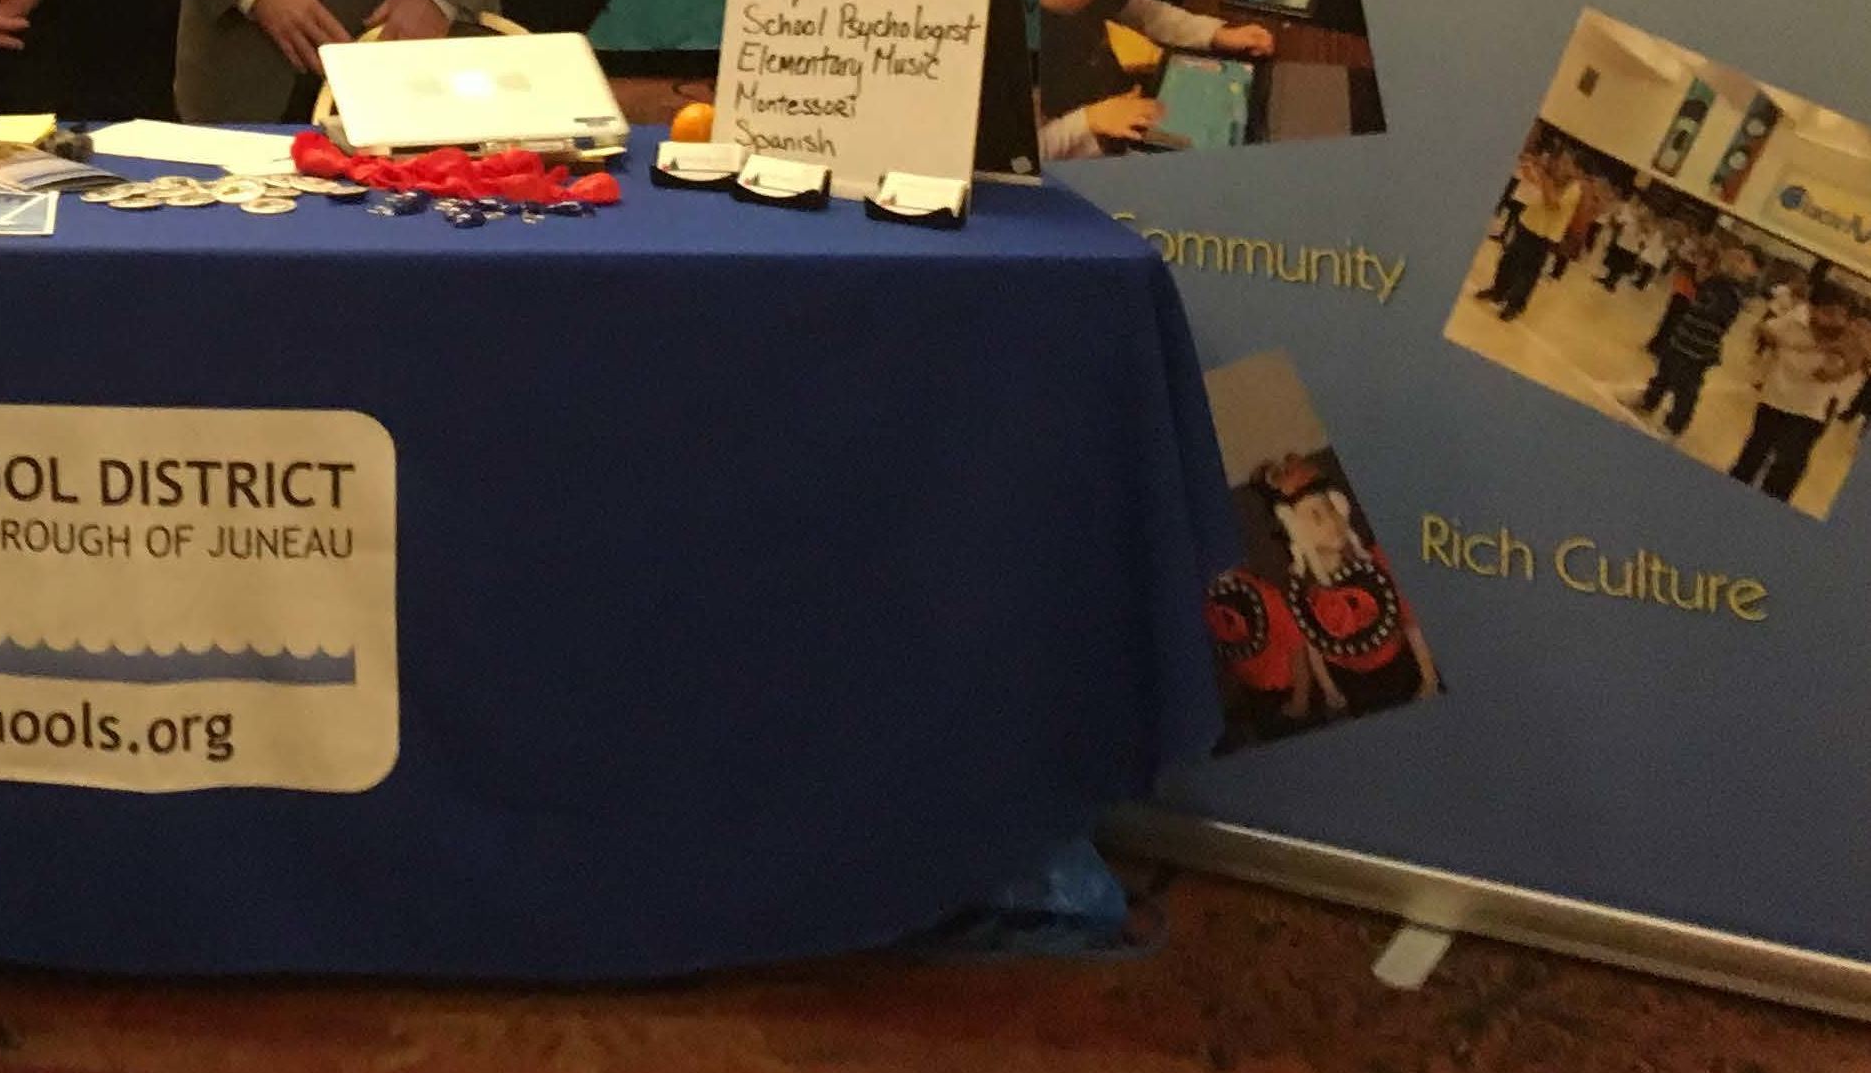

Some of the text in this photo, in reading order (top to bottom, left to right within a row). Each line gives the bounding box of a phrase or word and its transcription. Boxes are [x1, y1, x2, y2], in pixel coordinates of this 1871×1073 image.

[742, 2, 981, 54] School Psychologist
[737, 41, 940, 94] Elementary Music
[734, 80, 858, 118] Montessori
[734, 118, 837, 157] Spanish
[1114, 212, 1406, 304] ommunity
[100, 459, 355, 510] DISTRICT
[147, 524, 192, 559] OF
[208, 526, 353, 560] JUNEAU
[1422, 515, 1771, 622] Rich Culture
